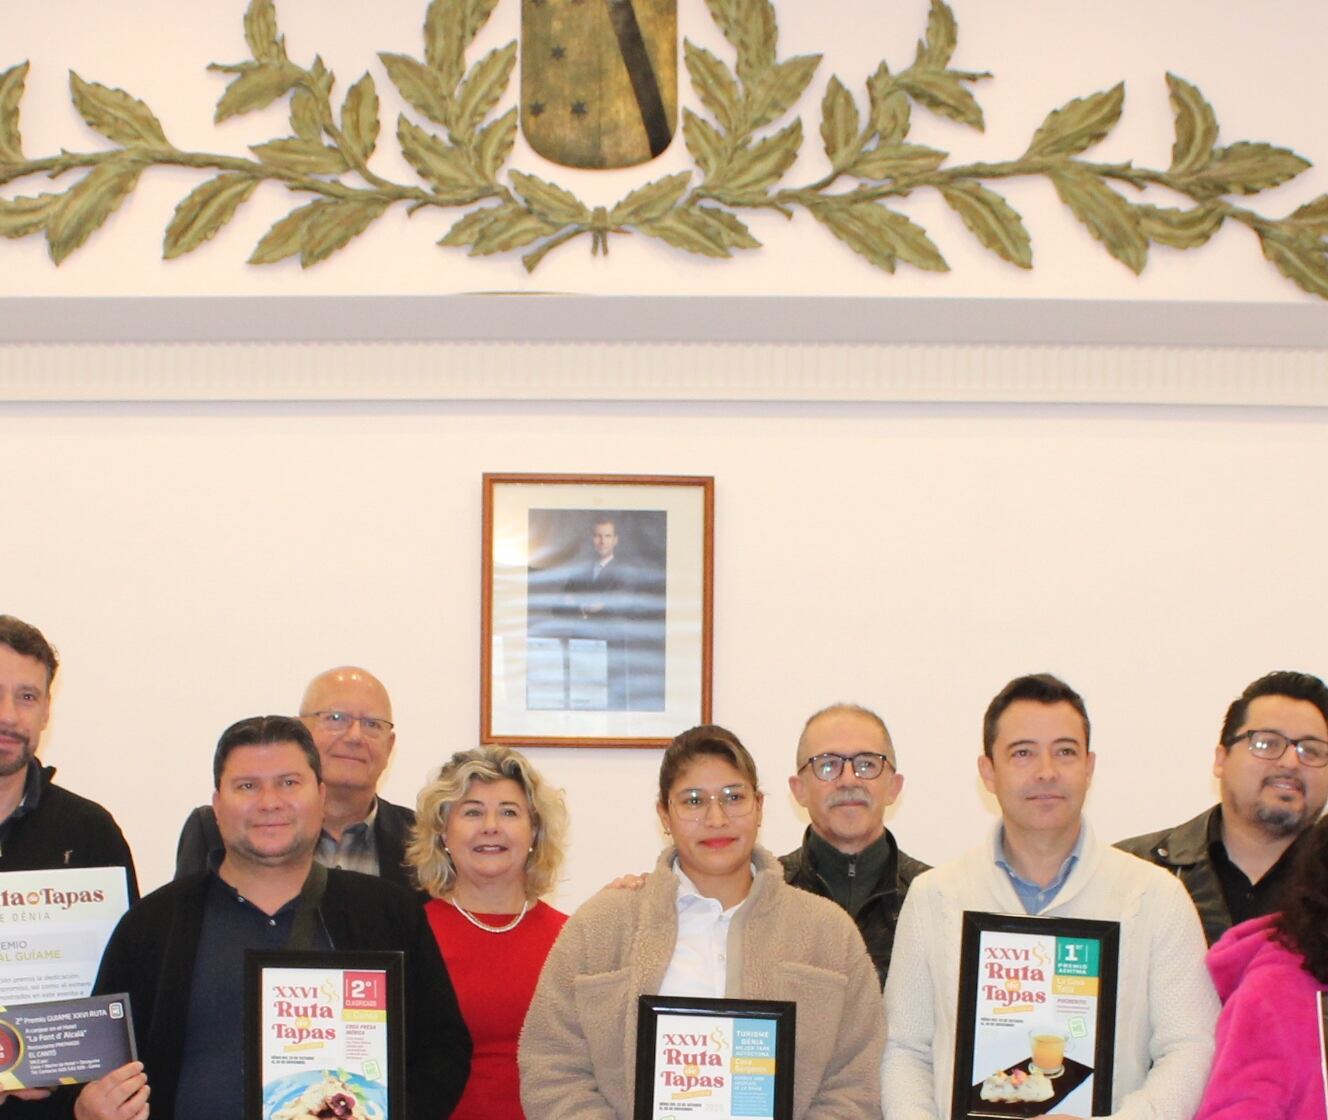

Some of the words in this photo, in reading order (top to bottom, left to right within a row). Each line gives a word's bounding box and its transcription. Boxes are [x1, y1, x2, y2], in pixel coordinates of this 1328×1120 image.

[39, 887, 104, 910] Tapas
[984, 947, 1030, 960] XXVI
[984, 962, 1045, 982] Ruta
[273, 986, 318, 998] XXVI
[982, 985, 1046, 1007] Tapas
[90, 1009, 107, 1017] RUTA
[273, 1001, 334, 1019] Ruta
[272, 1023, 336, 1044] Tapas
[662, 1034, 708, 1047] XXVI
[736, 1030, 769, 1038] TURISME
[663, 1048, 722, 1067] Ruta
[660, 1071, 725, 1092] Tapas
